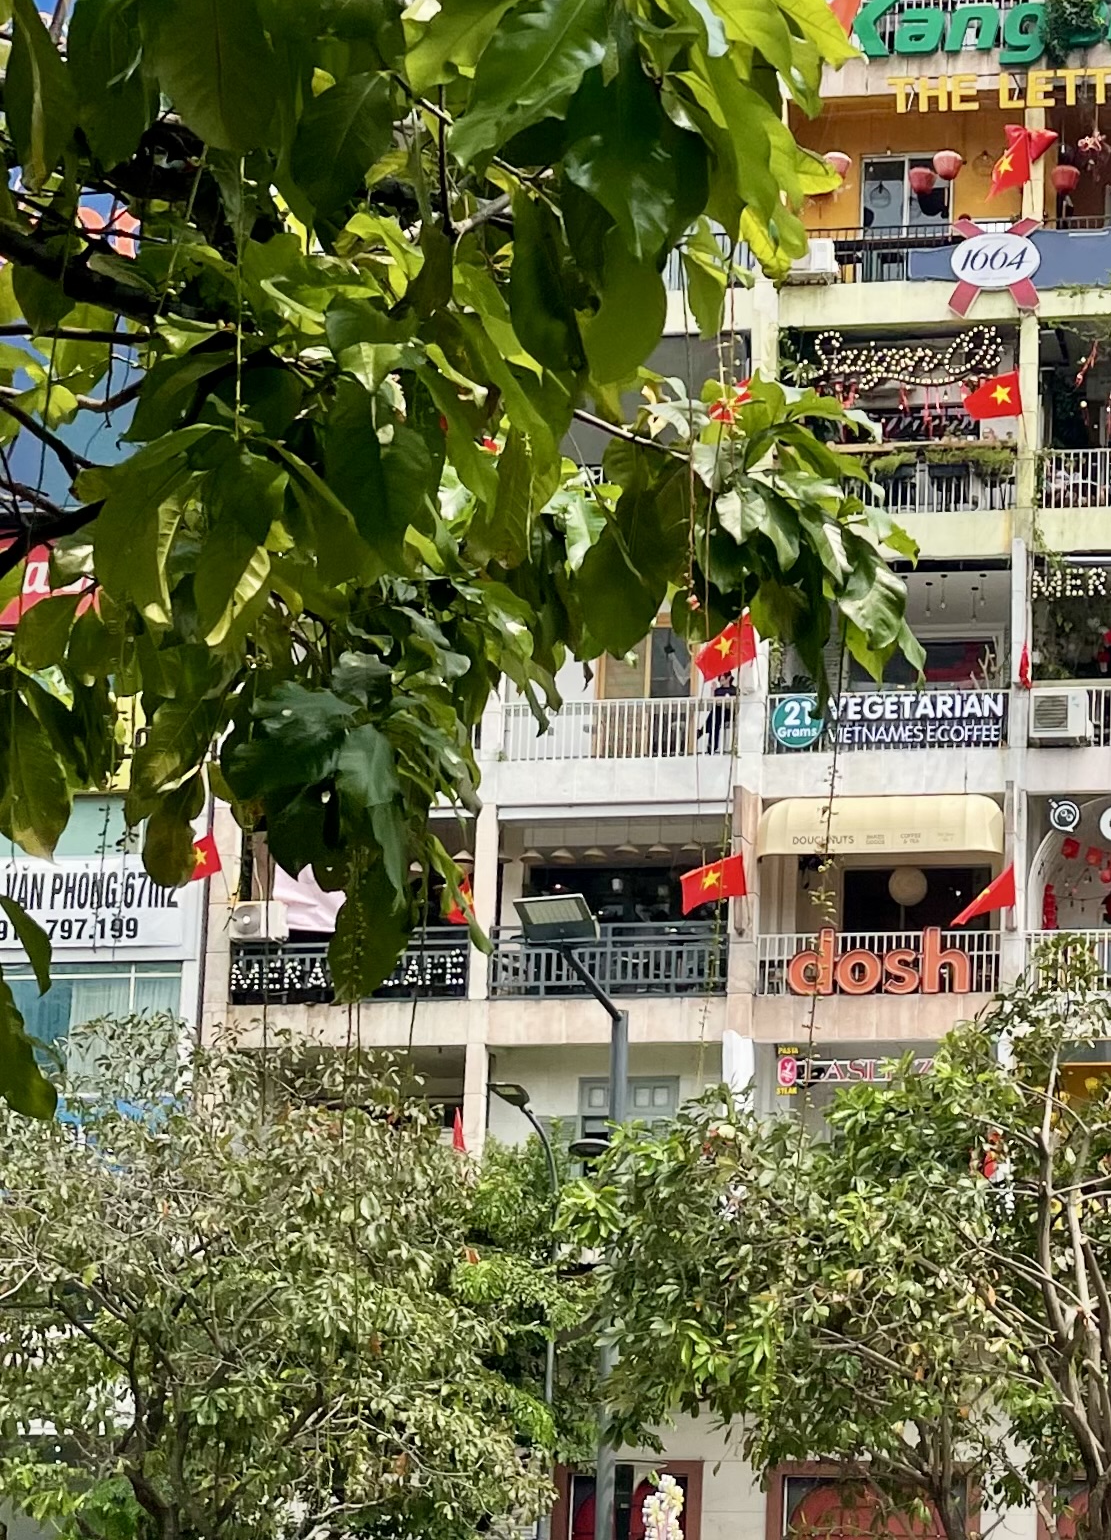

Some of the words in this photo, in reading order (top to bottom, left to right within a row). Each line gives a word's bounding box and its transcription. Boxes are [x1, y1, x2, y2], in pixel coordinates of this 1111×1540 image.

[887, 73, 980, 114] THE
[960, 243, 1029, 272] 1664
[784, 700, 812, 727] 21
[828, 694, 1004, 721] VEGETARIAN
[777, 726, 817, 738] Grams
[6, 865, 45, 910] VĂN
[230, 961, 345, 990] MERA
[788, 927, 970, 995] dosh
